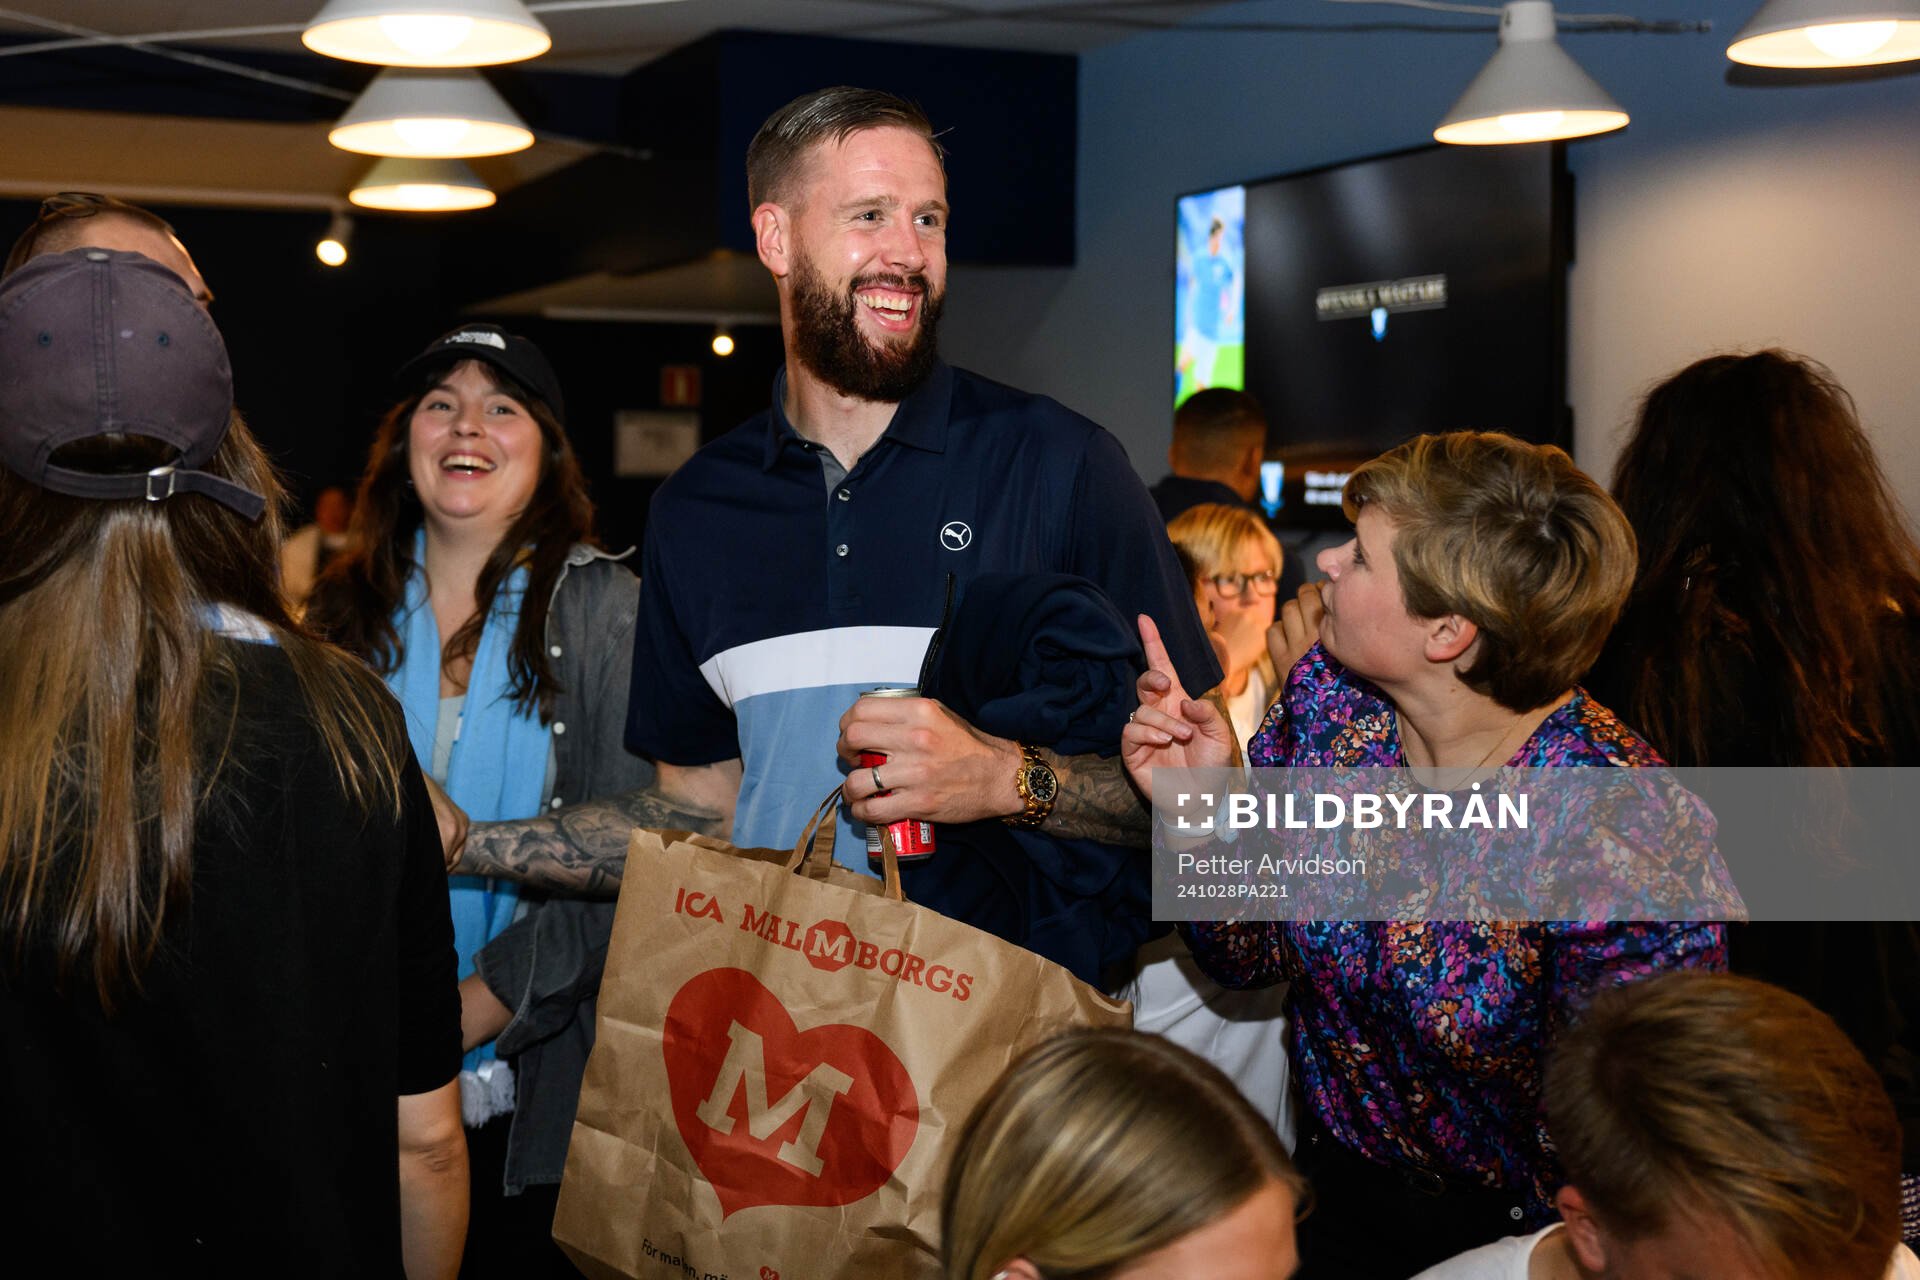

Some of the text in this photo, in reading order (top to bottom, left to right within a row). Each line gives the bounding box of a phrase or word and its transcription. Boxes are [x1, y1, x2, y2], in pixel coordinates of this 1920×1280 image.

[674, 887, 975, 1002] ICA MALMBORGS
[695, 1018, 855, 1179] M
[641, 1237, 657, 1259] För
